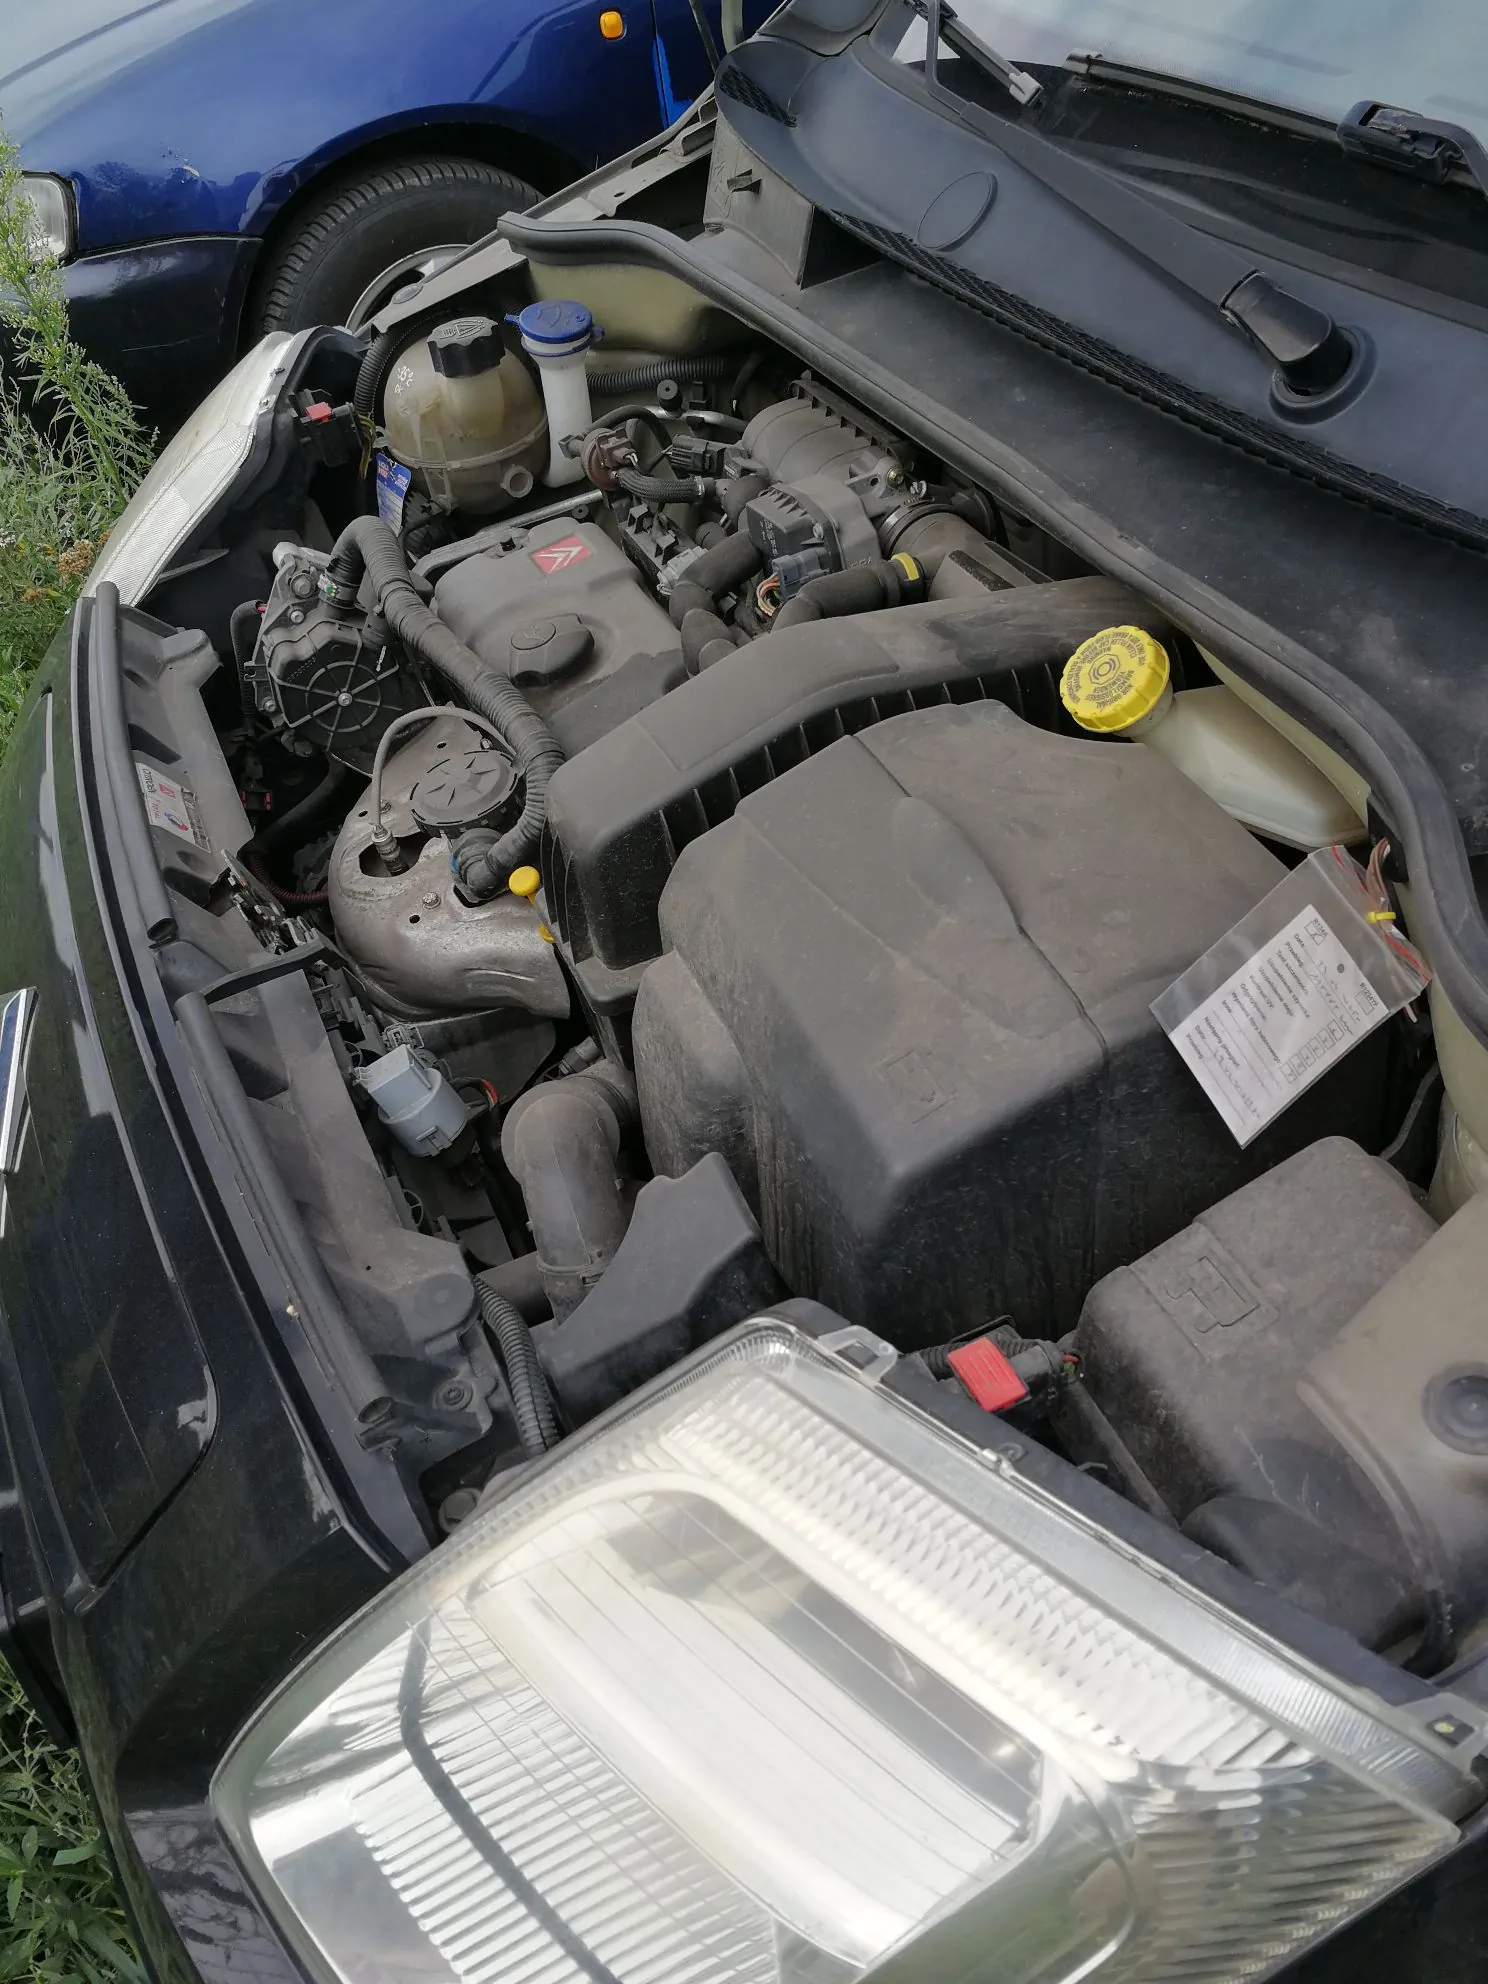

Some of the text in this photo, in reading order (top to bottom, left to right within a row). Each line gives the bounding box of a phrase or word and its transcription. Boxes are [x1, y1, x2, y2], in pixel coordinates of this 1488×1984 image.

[1094, 634, 1110, 644] FLUID
[1099, 640, 1109, 648] CAP
[1079, 646, 1097, 664] BEFORE
[1080, 642, 1094, 655] FROM
[1087, 645, 1111, 663] WARNING
[1127, 642, 1137, 658] CLEAN
[1137, 644, 1145, 654] ONLY
[1093, 672, 1126, 693] VERWENDEN
[1096, 684, 1133, 708] NUR ORIGINAL
[1313, 919, 1327, 936] R134A
